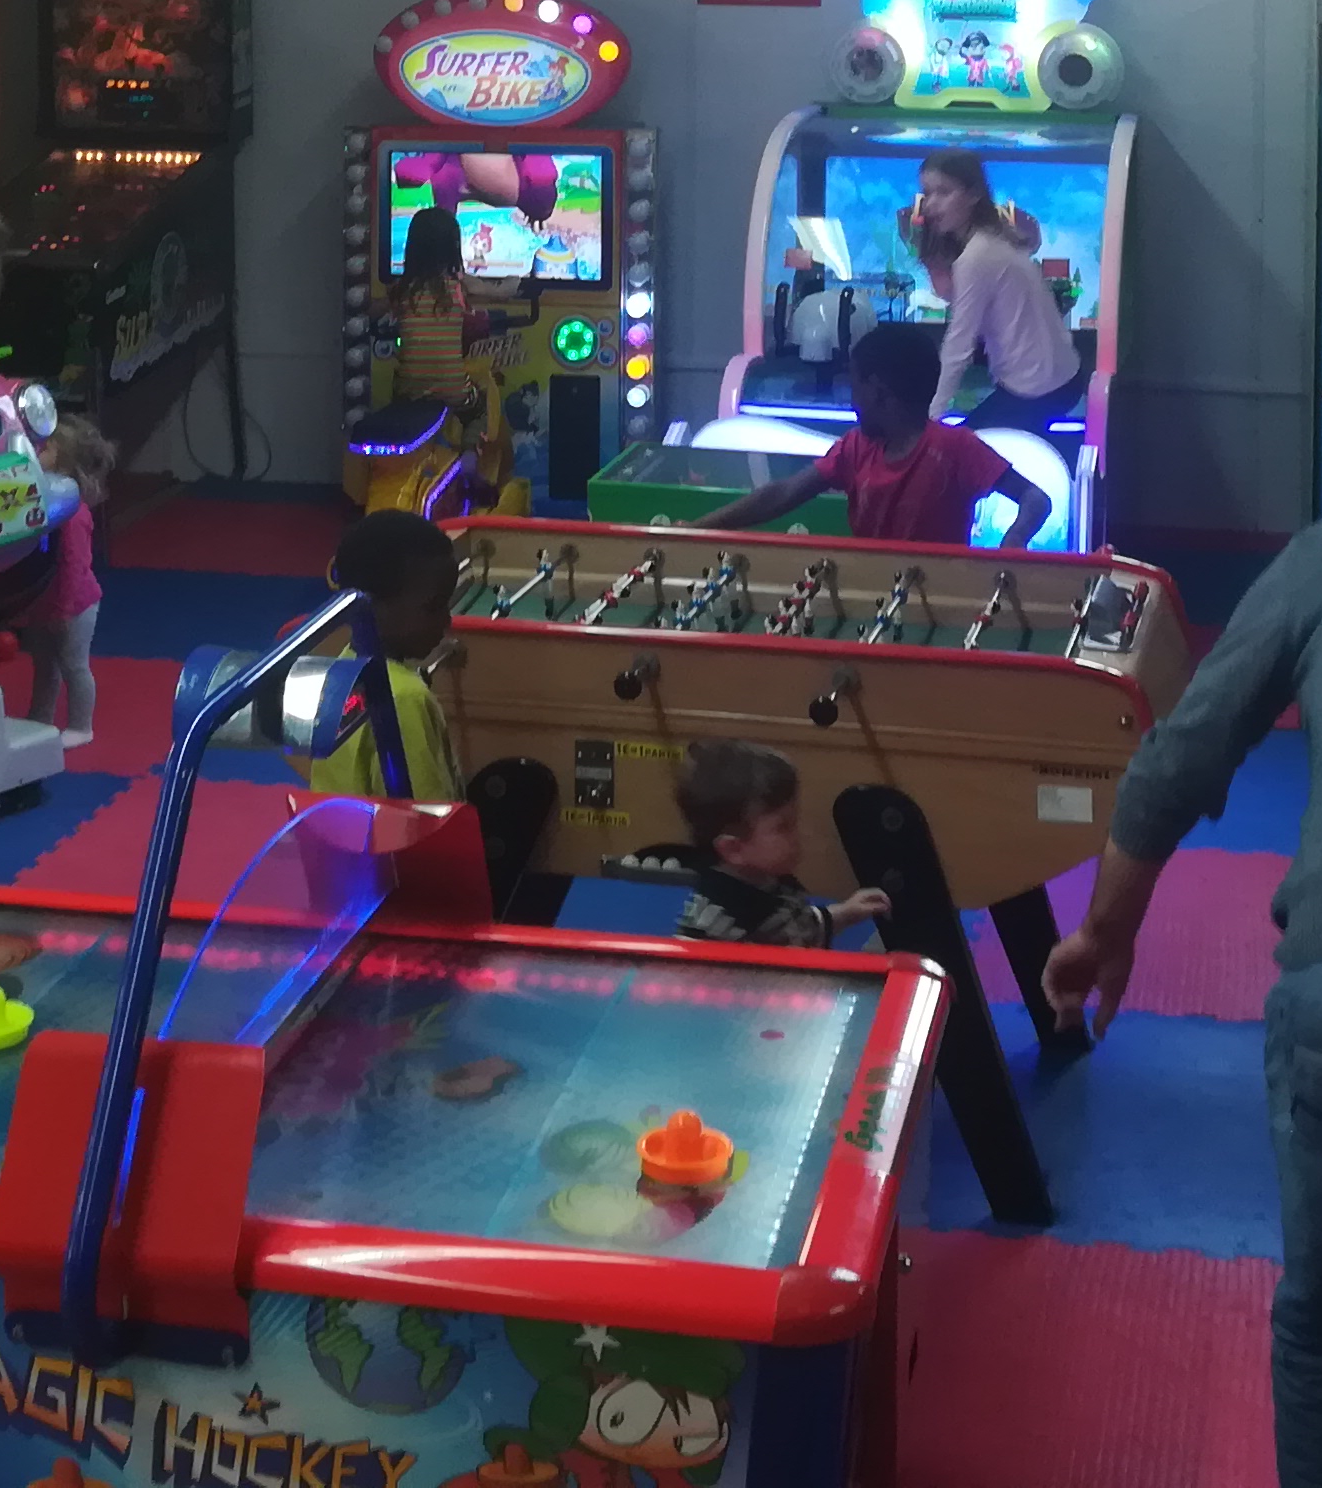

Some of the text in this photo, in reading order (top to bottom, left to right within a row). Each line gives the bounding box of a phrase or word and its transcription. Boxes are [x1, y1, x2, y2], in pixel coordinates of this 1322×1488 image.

[415, 44, 529, 81] SURFER
[466, 75, 544, 109] BIKE
[161, 1402, 417, 1488] HOCKEY
